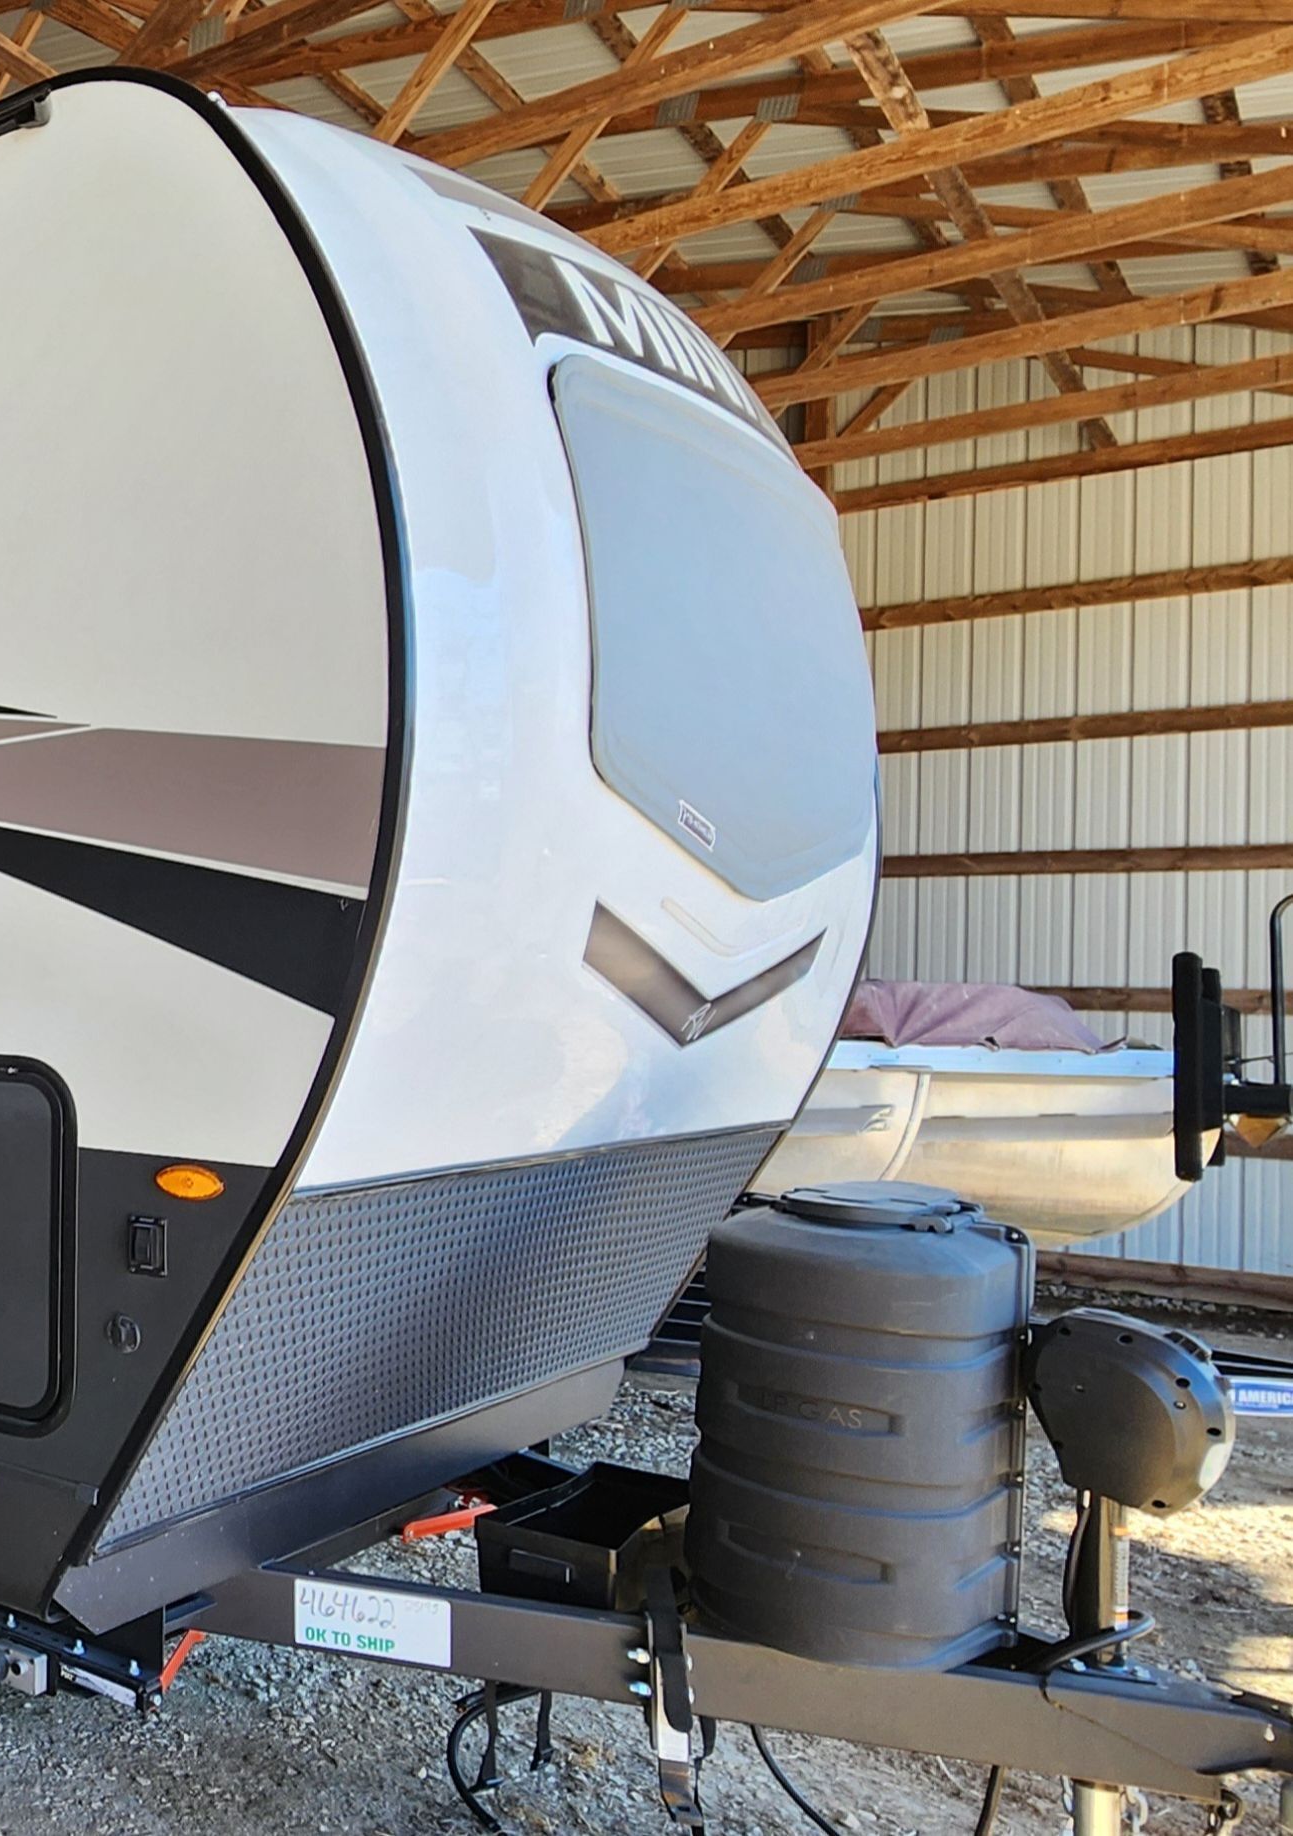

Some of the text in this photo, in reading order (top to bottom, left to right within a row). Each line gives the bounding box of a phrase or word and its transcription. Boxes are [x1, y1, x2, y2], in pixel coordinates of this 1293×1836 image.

[798, 1400, 862, 1429] GAS
[305, 1626, 396, 1653] OK TO SHIP
